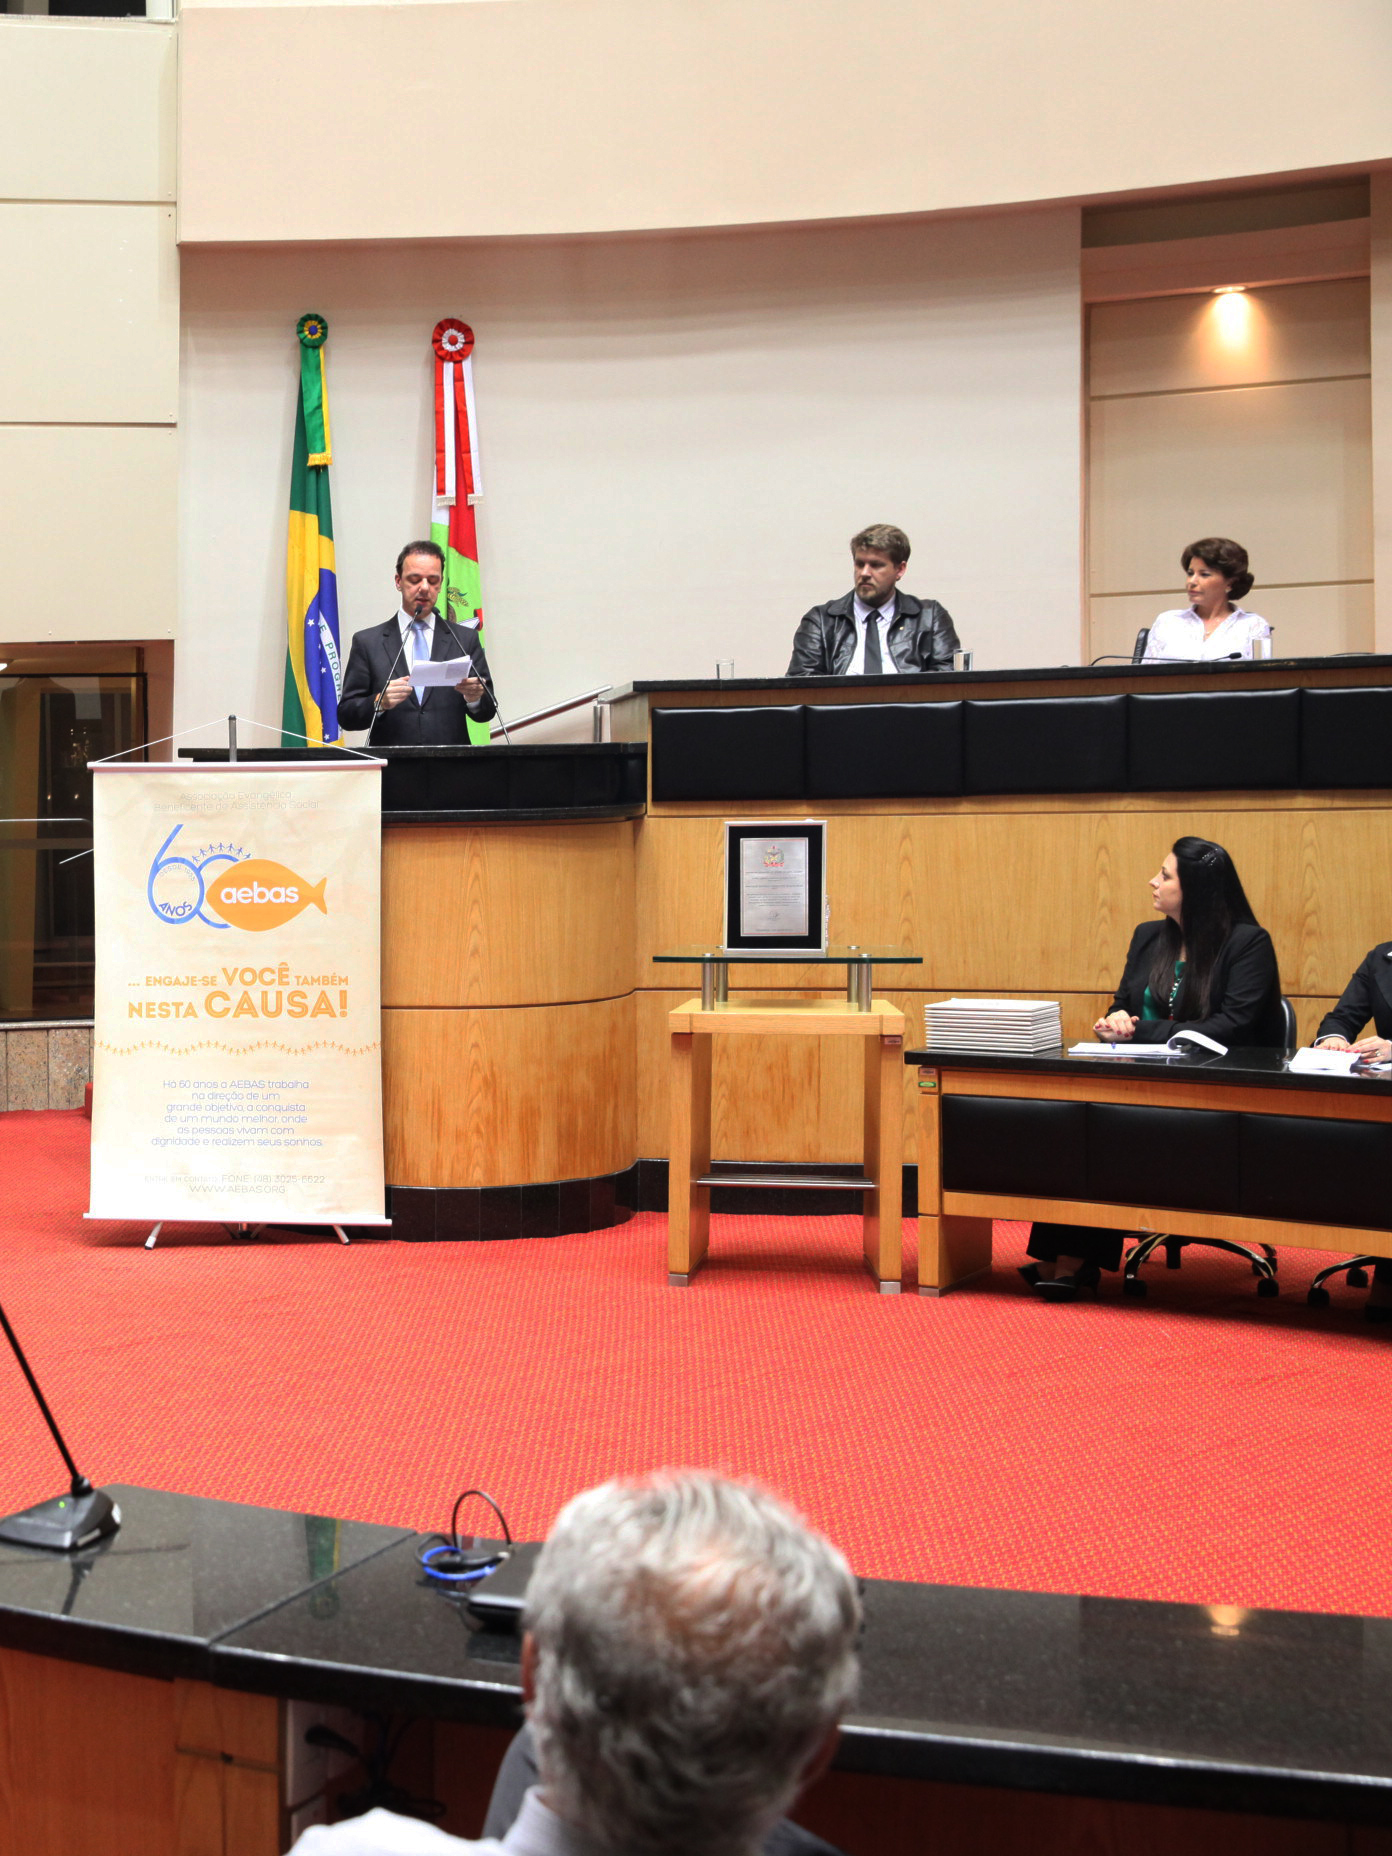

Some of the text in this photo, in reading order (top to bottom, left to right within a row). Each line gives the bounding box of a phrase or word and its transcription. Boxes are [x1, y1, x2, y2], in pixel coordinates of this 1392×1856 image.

[220, 881, 300, 904] aebas
[158, 901, 193, 917] ANOS
[145, 975, 217, 987] ENGAJE-SE
[221, 961, 291, 986] VOCÊ
[294, 972, 349, 986] TAMBÉM
[128, 989, 348, 1019] NESTA CAUSA!
[179, 1080, 191, 1089] 60
[193, 1081, 218, 1089] anos
[229, 1080, 266, 1089] AEBAS
[267, 1080, 310, 1089] trabalha
[191, 1091, 281, 1102] na direção de um
[166, 1103, 203, 1113] grande
[256, 1103, 306, 1113] conquista
[164, 1114, 178, 1123] de
[179, 1115, 199, 1123] um
[200, 1114, 239, 1123] mundo
[281, 1114, 308, 1123] onde
[177, 1126, 295, 1137] as pessoas vivam com
[151, 1136, 201, 1148] dignidade
[211, 1136, 255, 1146] realizem
[257, 1137, 282, 1146] seus
